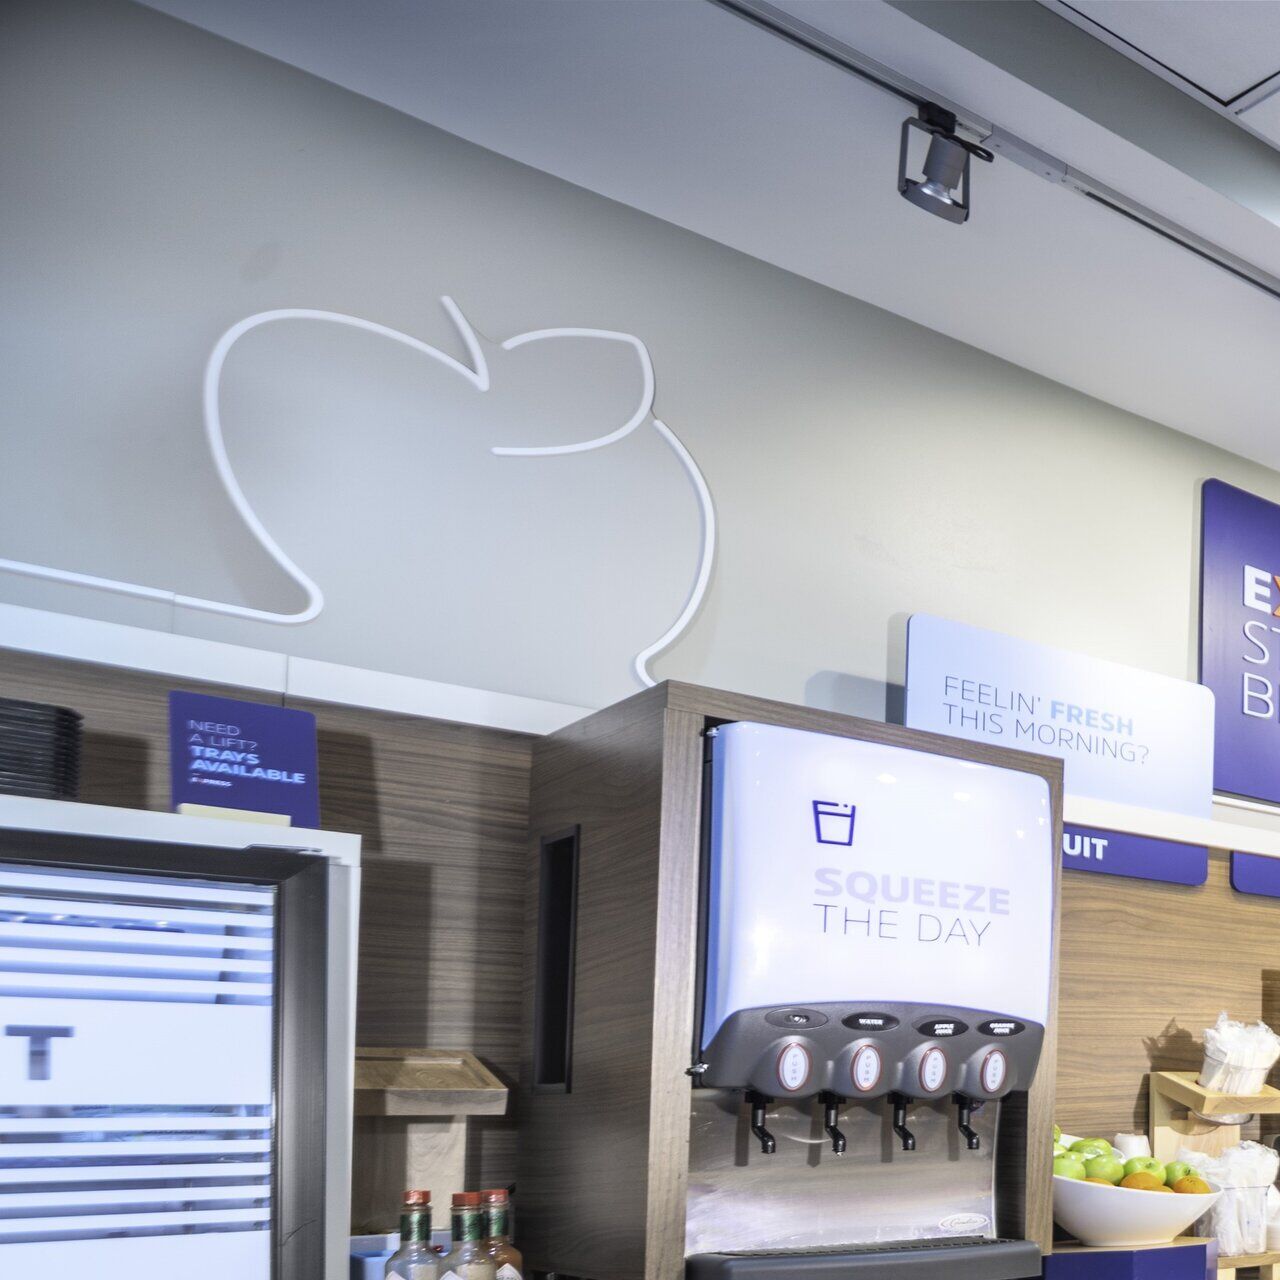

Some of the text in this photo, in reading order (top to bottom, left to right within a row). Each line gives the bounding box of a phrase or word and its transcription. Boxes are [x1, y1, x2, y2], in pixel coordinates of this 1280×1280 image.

[944, 675, 1134, 736] FEELIN' FRESH
[188, 719, 240, 736] NEED
[943, 702, 1149, 765] THIS MORNING?
[188, 733, 258, 752] A LIFT?
[190, 745, 260, 765] TRAYS
[189, 759, 306, 785] AVAILABLE
[1063, 833, 1108, 860] UIT
[813, 867, 1011, 916] SQUEEZE
[813, 903, 991, 946] THE DAY
[858, 1018, 883, 1026] WATER
